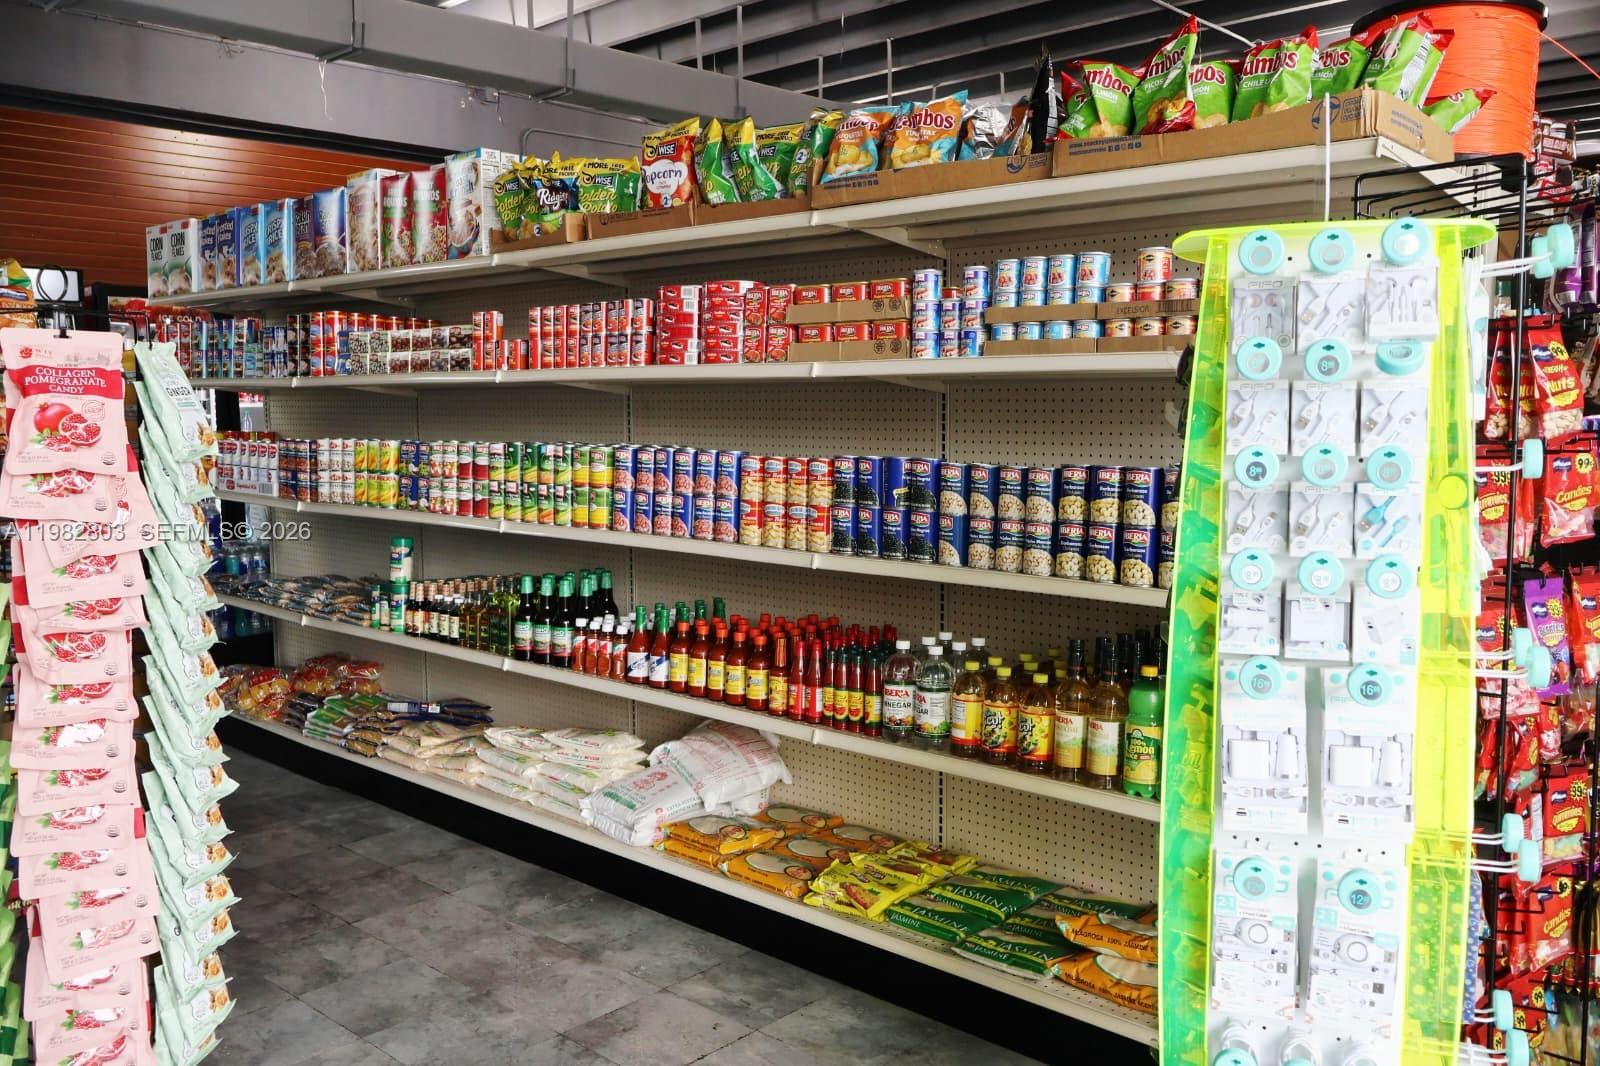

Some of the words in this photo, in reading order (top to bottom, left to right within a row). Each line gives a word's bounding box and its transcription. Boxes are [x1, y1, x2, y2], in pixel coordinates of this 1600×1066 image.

[1242, 50, 1299, 77] ambos
[658, 144, 676, 156] WISE
[587, 161, 609, 173] MORE
[505, 181, 520, 193] WISE
[595, 175, 613, 189] WISE
[150, 236, 164, 252] CORN
[170, 231, 186, 248] CORN
[172, 243, 186, 259] FLAKES
[35, 366, 97, 379] COLLAGEN
[25, 375, 107, 388] POMEGRANATE
[49, 384, 85, 394] CANDY
[1063, 469, 1087, 480] IBERIA
[1098, 470, 1125, 481] IBERIA
[1556, 485, 1592, 504] Candies
[1001, 520, 1025, 531] IBERIA
[1060, 525, 1084, 536] IBERIA
[1123, 531, 1148, 542] IBERIA
[890, 912, 922, 928] JASMINE
[1543, 908, 1572, 934] Candies
[997, 940, 1053, 963] JASMIN
